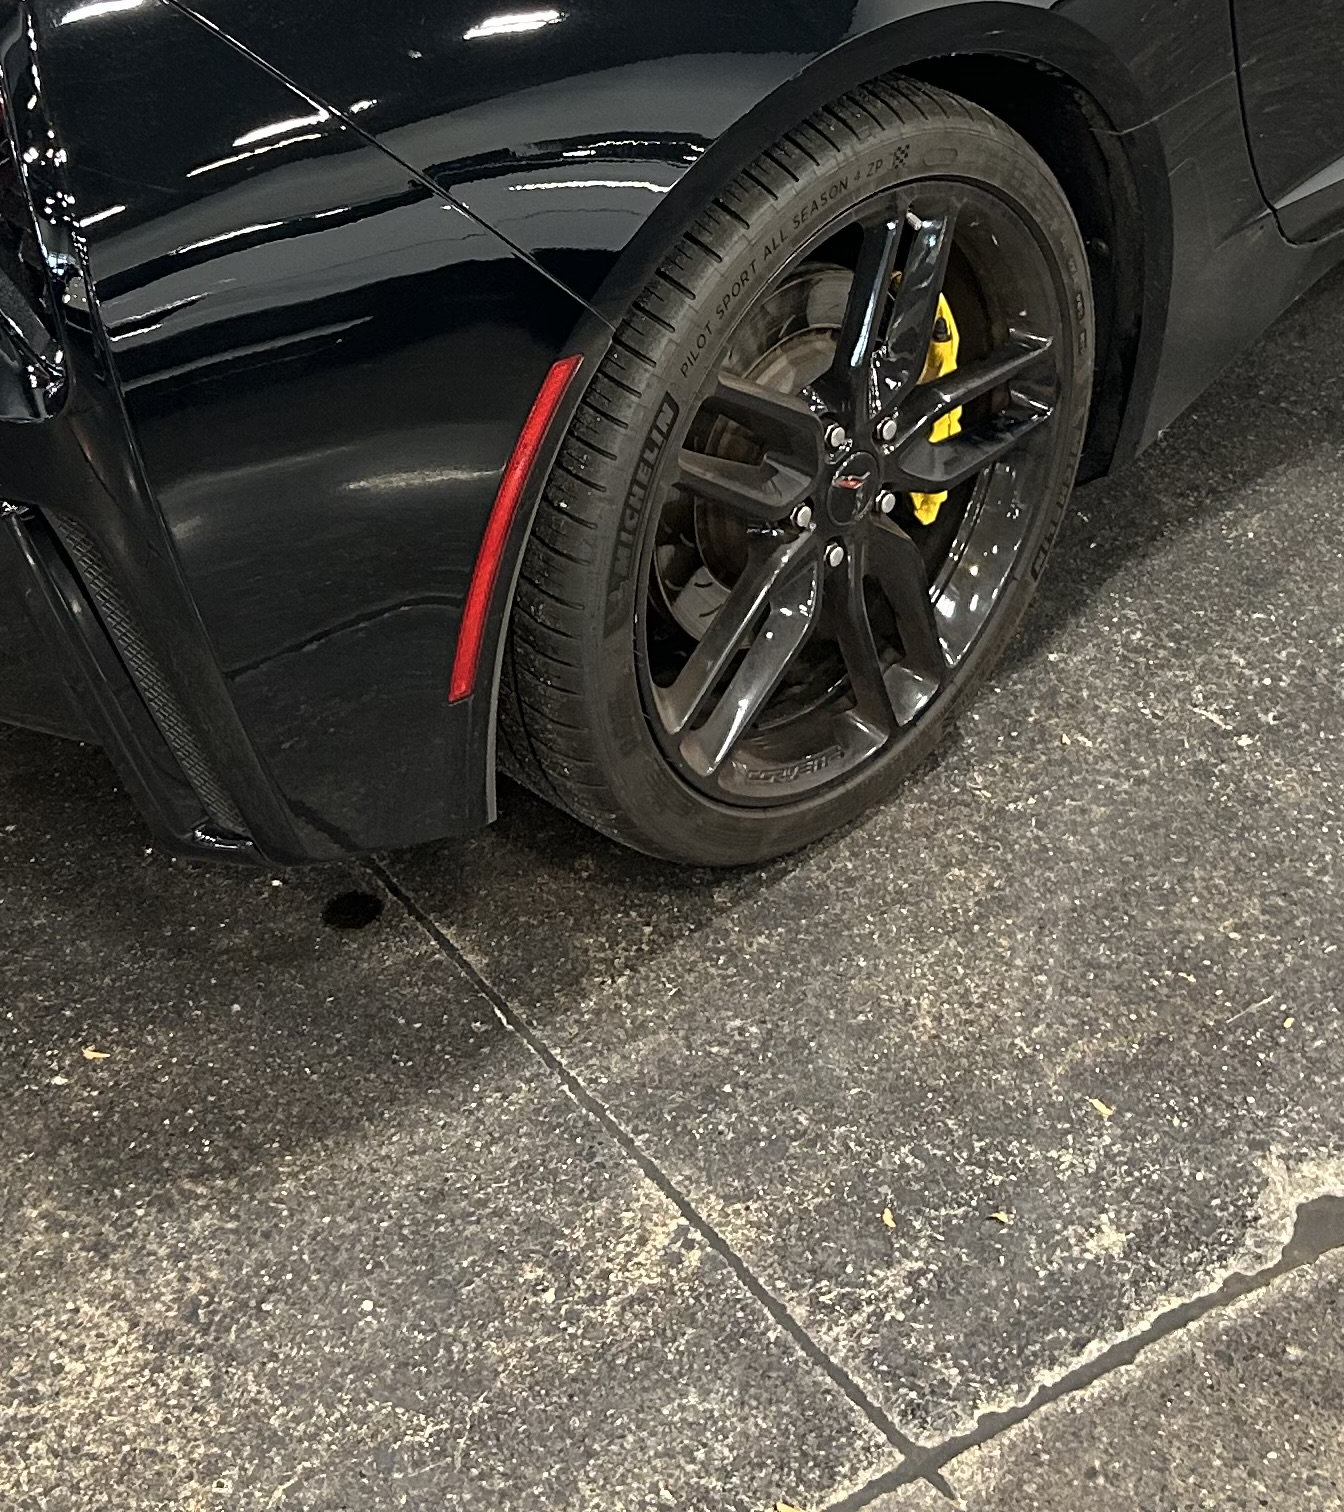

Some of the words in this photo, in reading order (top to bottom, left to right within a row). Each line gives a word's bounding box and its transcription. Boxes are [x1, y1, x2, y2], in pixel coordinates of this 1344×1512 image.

[680, 320, 712, 377] PILOT
[715, 258, 757, 320] SPORT
[763, 229, 788, 260] ALL
[792, 176, 848, 229] SEASON
[853, 170, 861, 181] 4
[865, 159, 883, 177] ZP
[612, 400, 676, 577] MICHELIN
